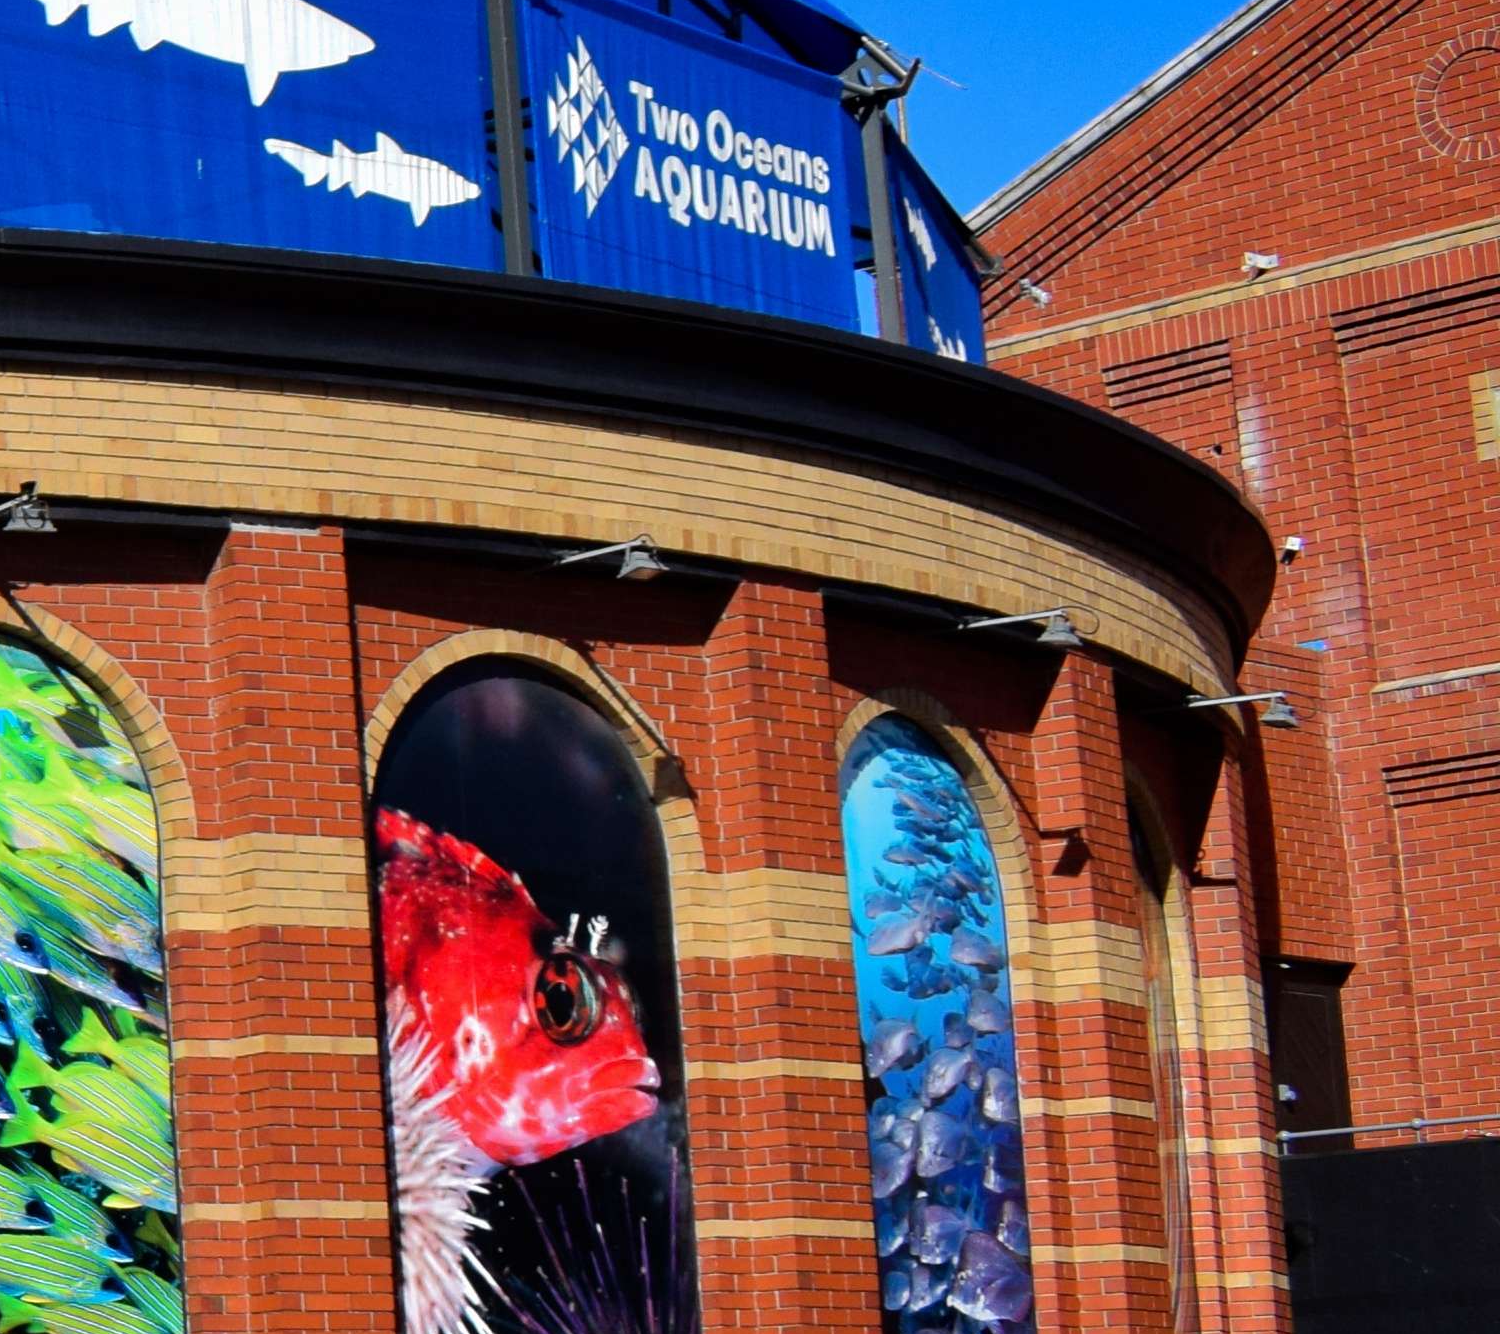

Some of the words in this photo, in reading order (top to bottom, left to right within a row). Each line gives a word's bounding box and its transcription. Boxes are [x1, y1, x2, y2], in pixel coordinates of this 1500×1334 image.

[628, 80, 700, 152] Two
[706, 109, 831, 194] Oceans
[634, 146, 836, 258] AQUARIUM
